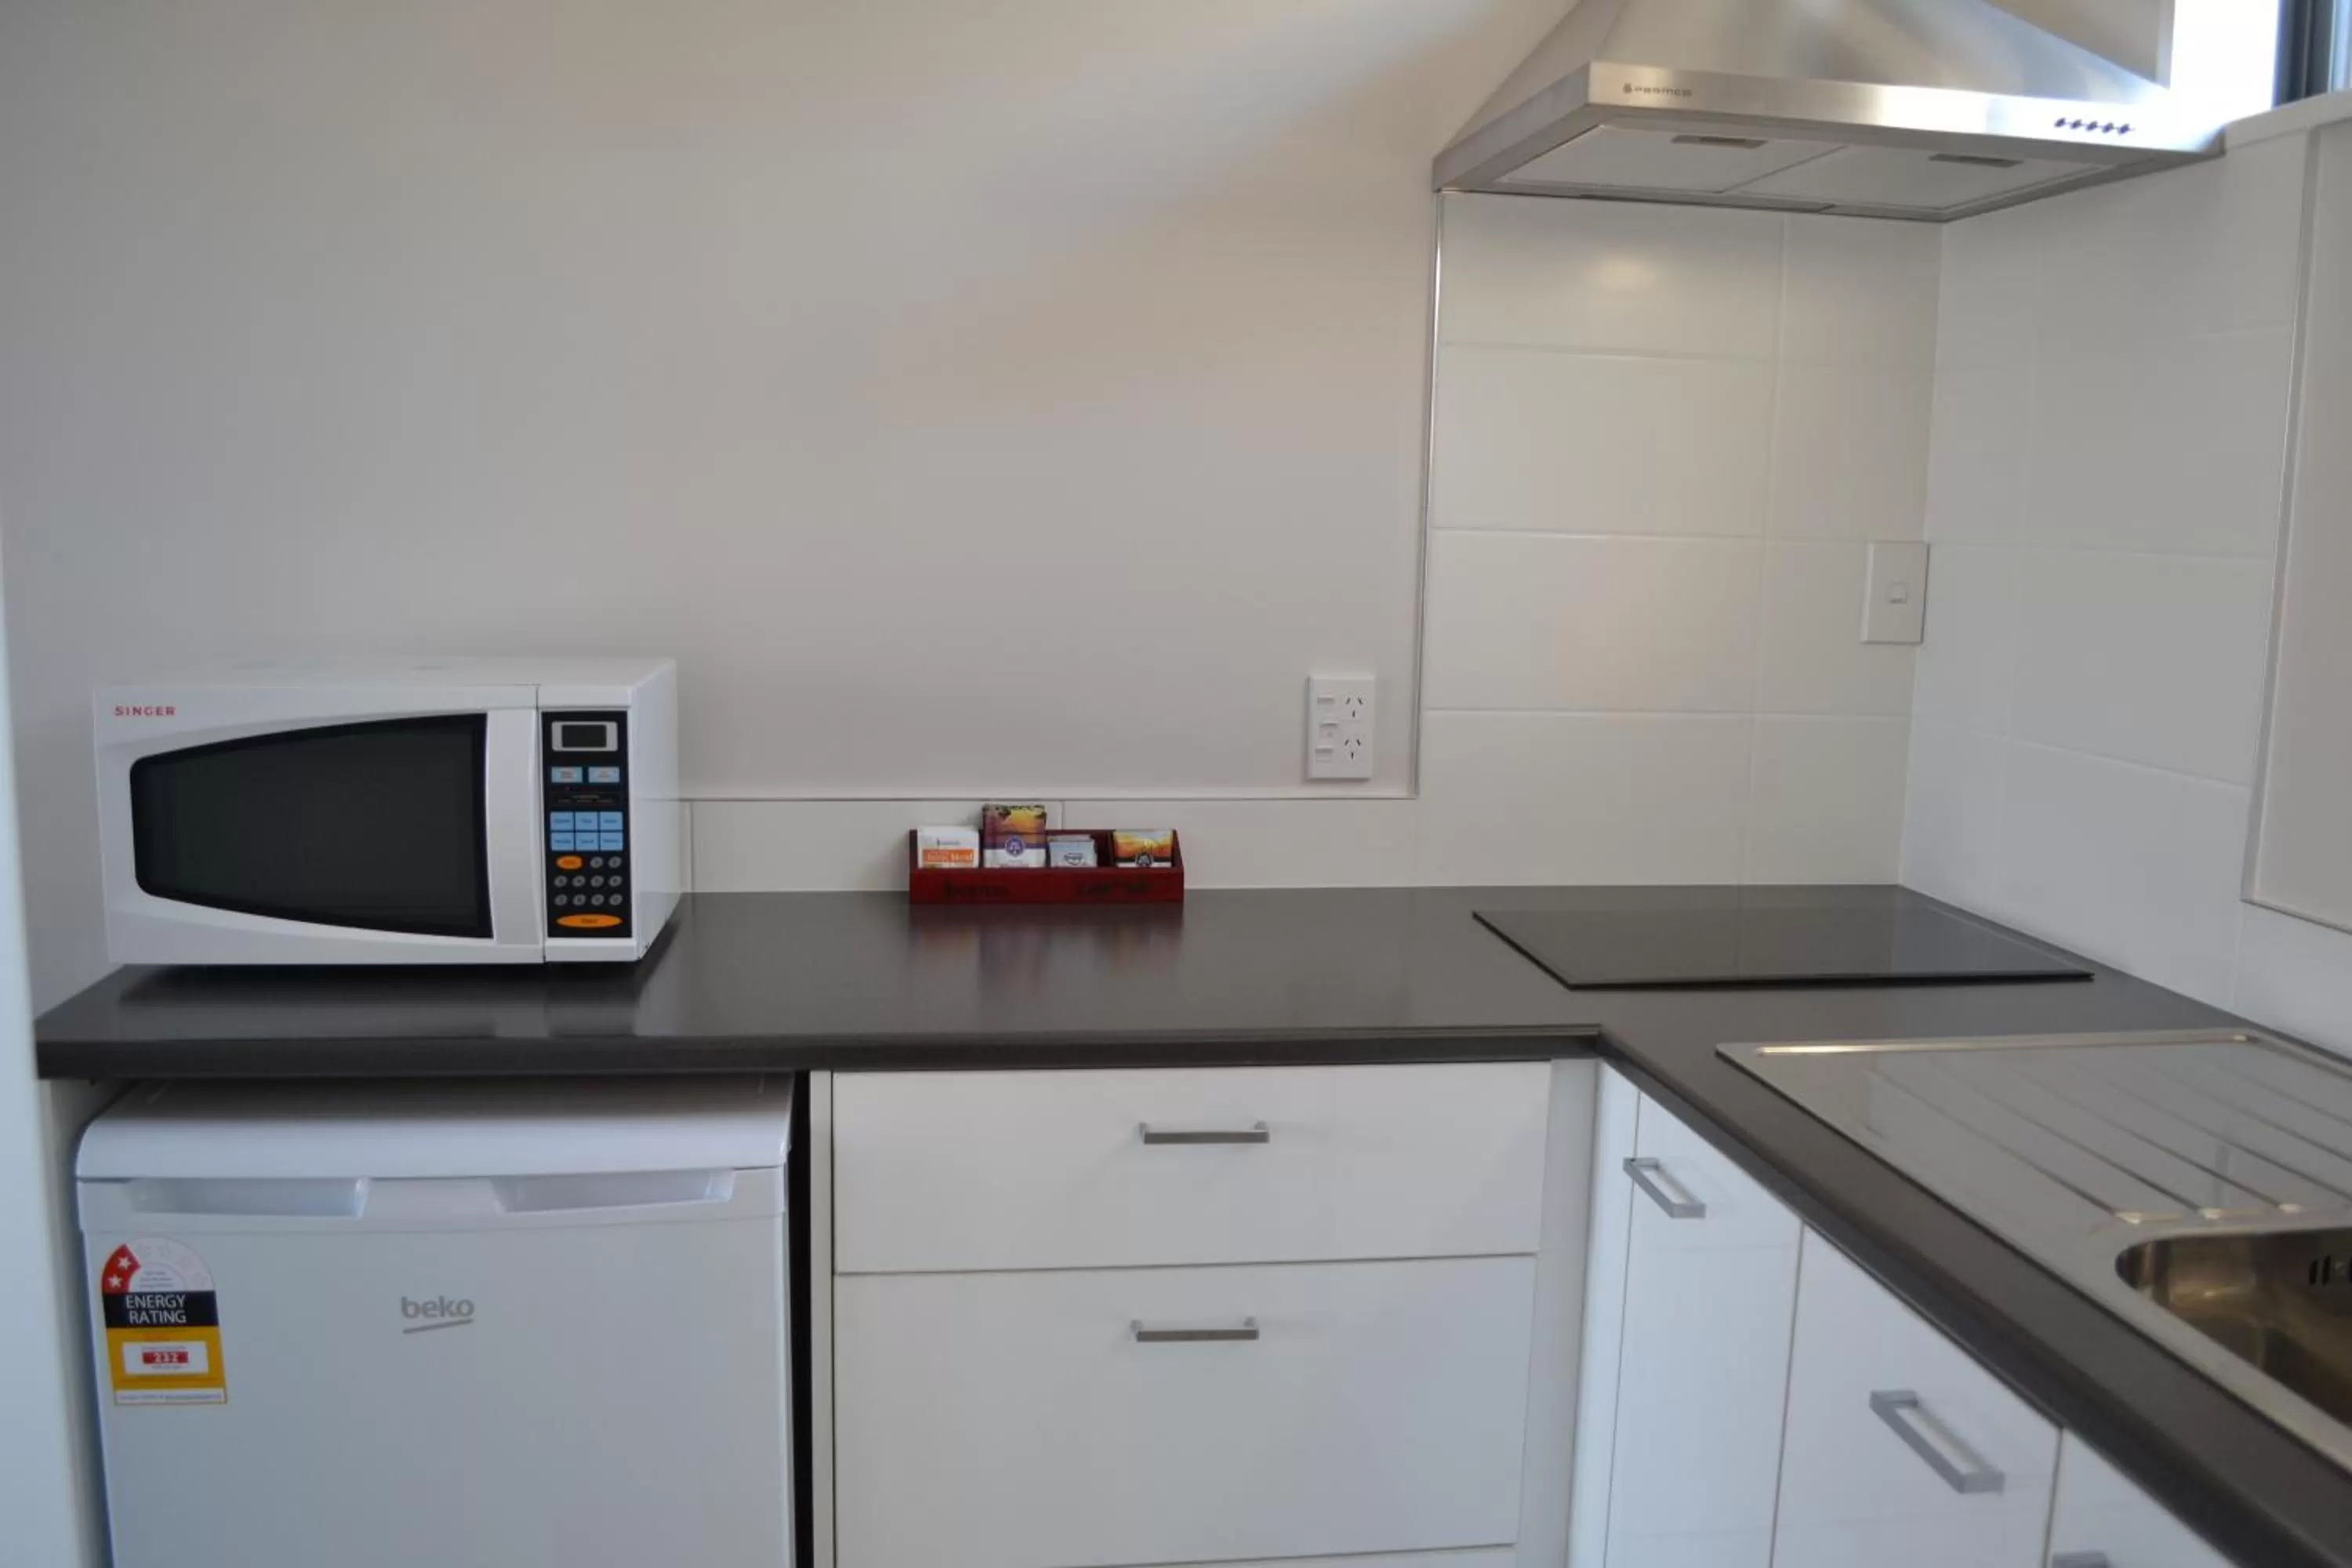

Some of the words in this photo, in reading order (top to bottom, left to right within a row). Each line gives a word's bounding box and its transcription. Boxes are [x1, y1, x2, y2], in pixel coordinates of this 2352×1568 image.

[114, 706, 176, 716] SINGER
[125, 1294, 187, 1309] ENERGY
[401, 1295, 474, 1318] beko
[129, 1309, 187, 1324] RATING
